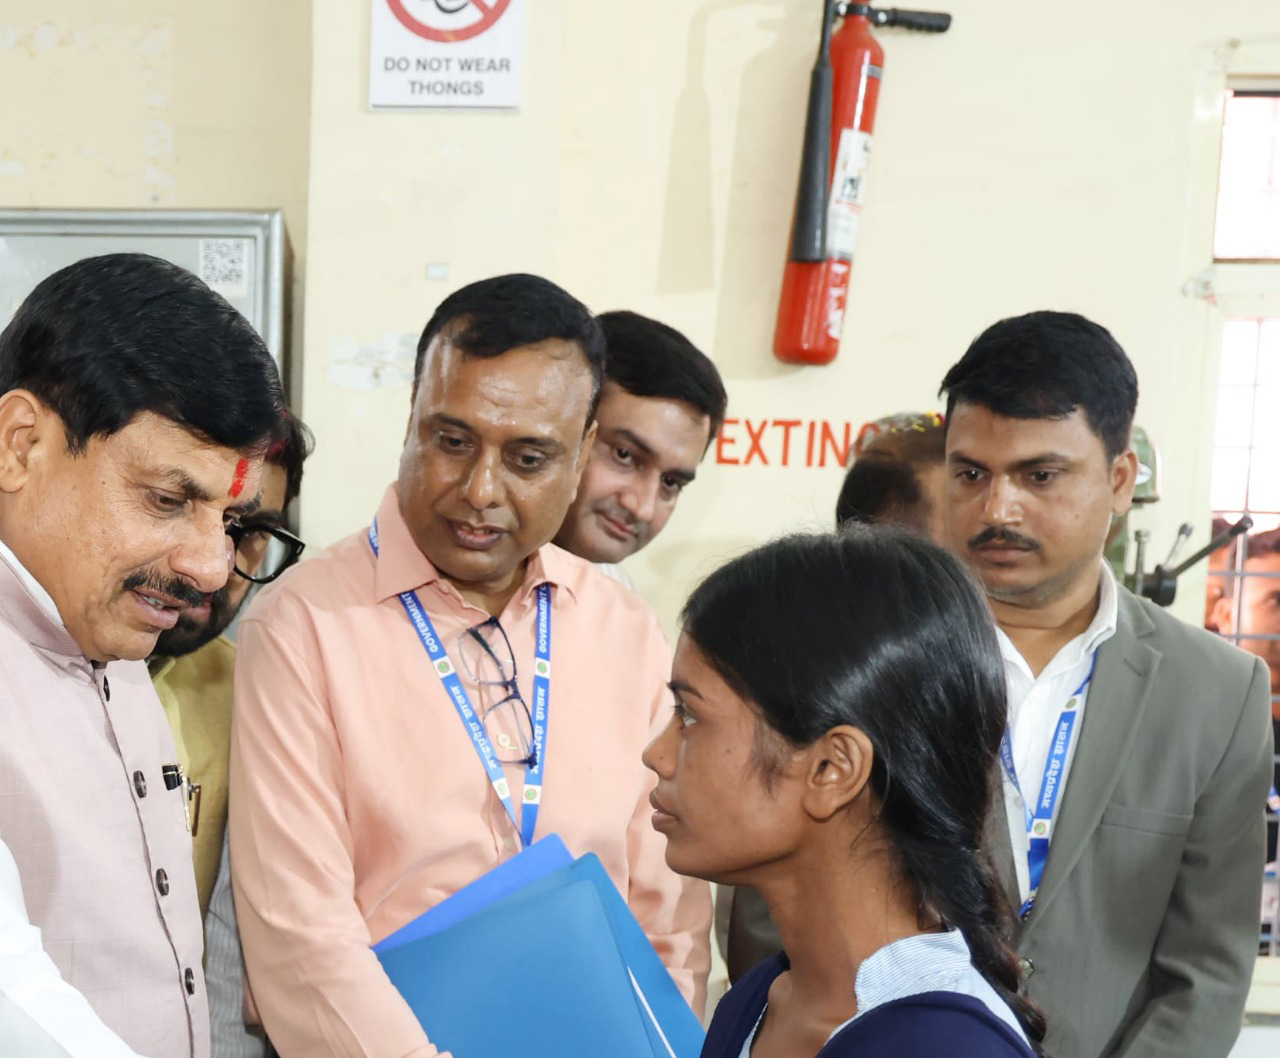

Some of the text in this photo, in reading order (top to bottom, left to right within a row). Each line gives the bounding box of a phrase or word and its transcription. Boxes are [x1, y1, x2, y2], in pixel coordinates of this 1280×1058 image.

[384, 57, 511, 73] DO NOT WEAR
[408, 80, 485, 95] THONGS
[401, 591, 439, 654] GOVERNMENT
[538, 591, 548, 653] GOVERNMENT
